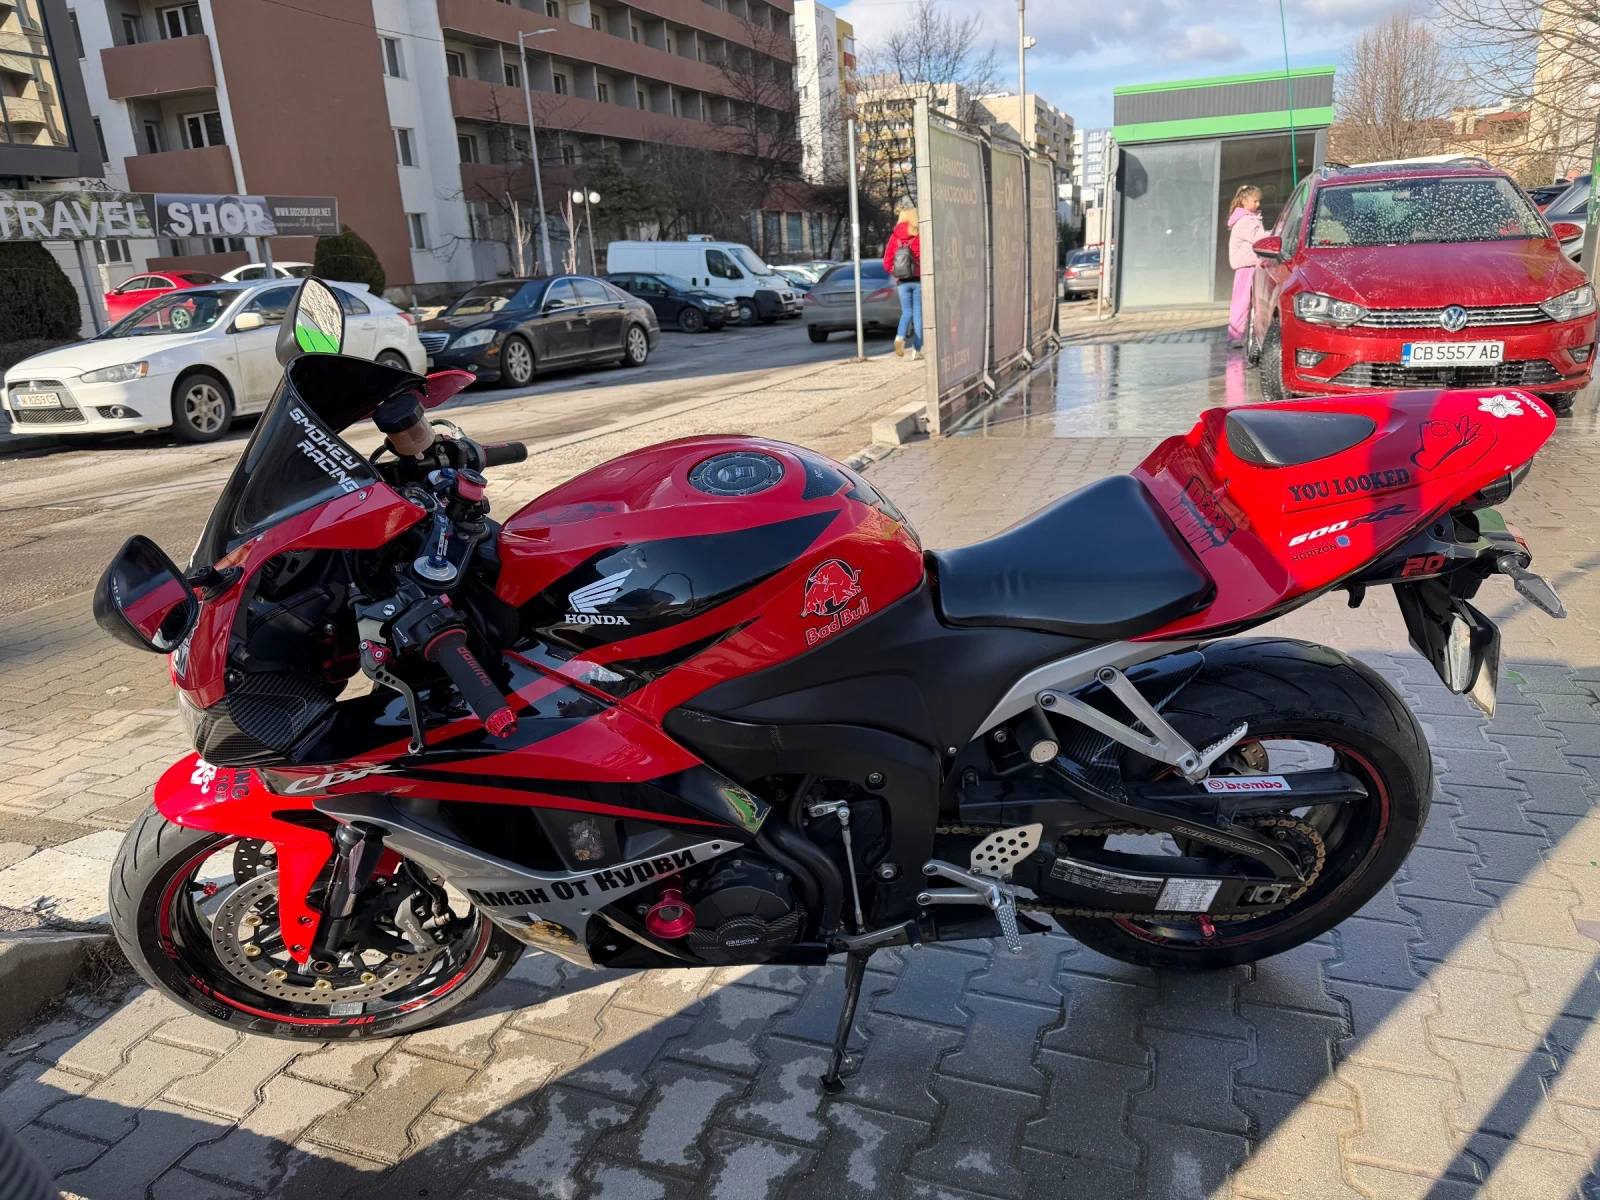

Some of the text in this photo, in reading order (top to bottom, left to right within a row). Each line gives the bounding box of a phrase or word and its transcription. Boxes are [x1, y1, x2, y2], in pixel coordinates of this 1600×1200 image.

[0, 200, 265, 237] TRAVEL SHOP
[1436, 345, 1476, 360] 5557
[1479, 344, 1500, 359] AB
[1510, 391, 1549, 418] HONDA
[289, 407, 361, 470] SMOKEY
[296, 440, 361, 493] RACING
[1288, 468, 1410, 502] YOU LOOKED
[1291, 543, 1338, 563] HORIZON
[1401, 553, 1446, 578] 20
[564, 614, 631, 626] HONDA
[805, 596, 870, 646] Bad Bull
[456, 646, 492, 687] domino
[284, 764, 405, 794] CBR
[1224, 780, 1283, 790] brembo
[592, 849, 698, 891] Курви
[404, 919, 425, 944] TOKICO
